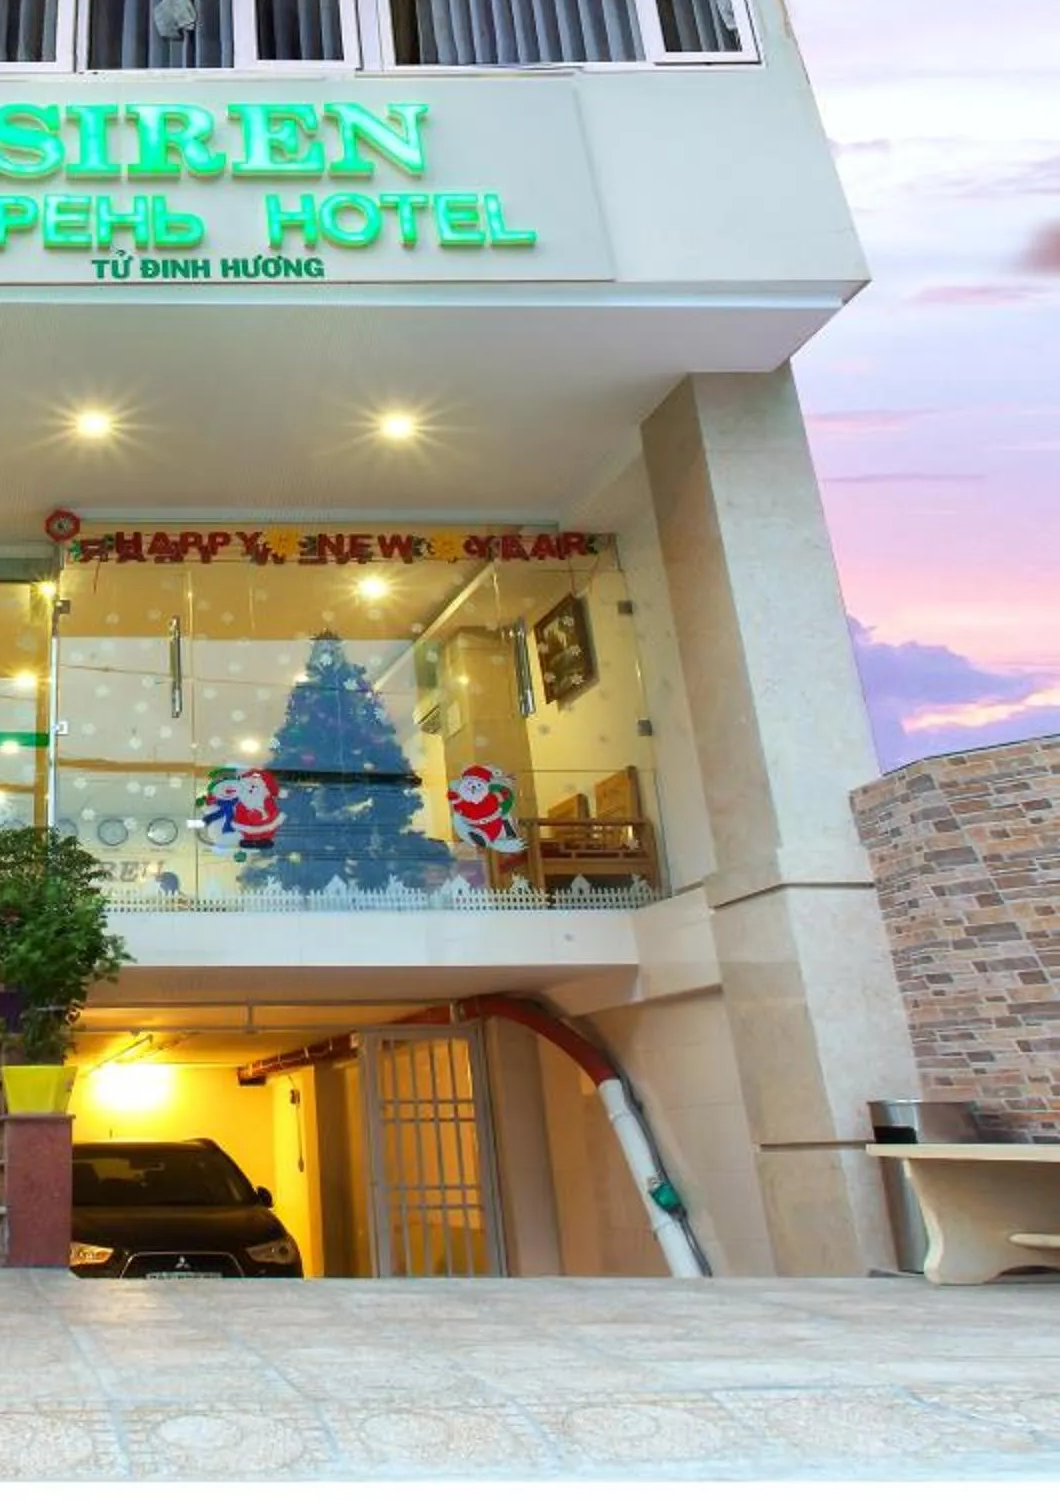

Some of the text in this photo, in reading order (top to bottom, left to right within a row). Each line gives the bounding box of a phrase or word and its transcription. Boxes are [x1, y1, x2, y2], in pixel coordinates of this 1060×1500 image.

[265, 192, 537, 250] HOTEL
[115, 531, 263, 556] HAPPY
[316, 533, 415, 563] NEW
